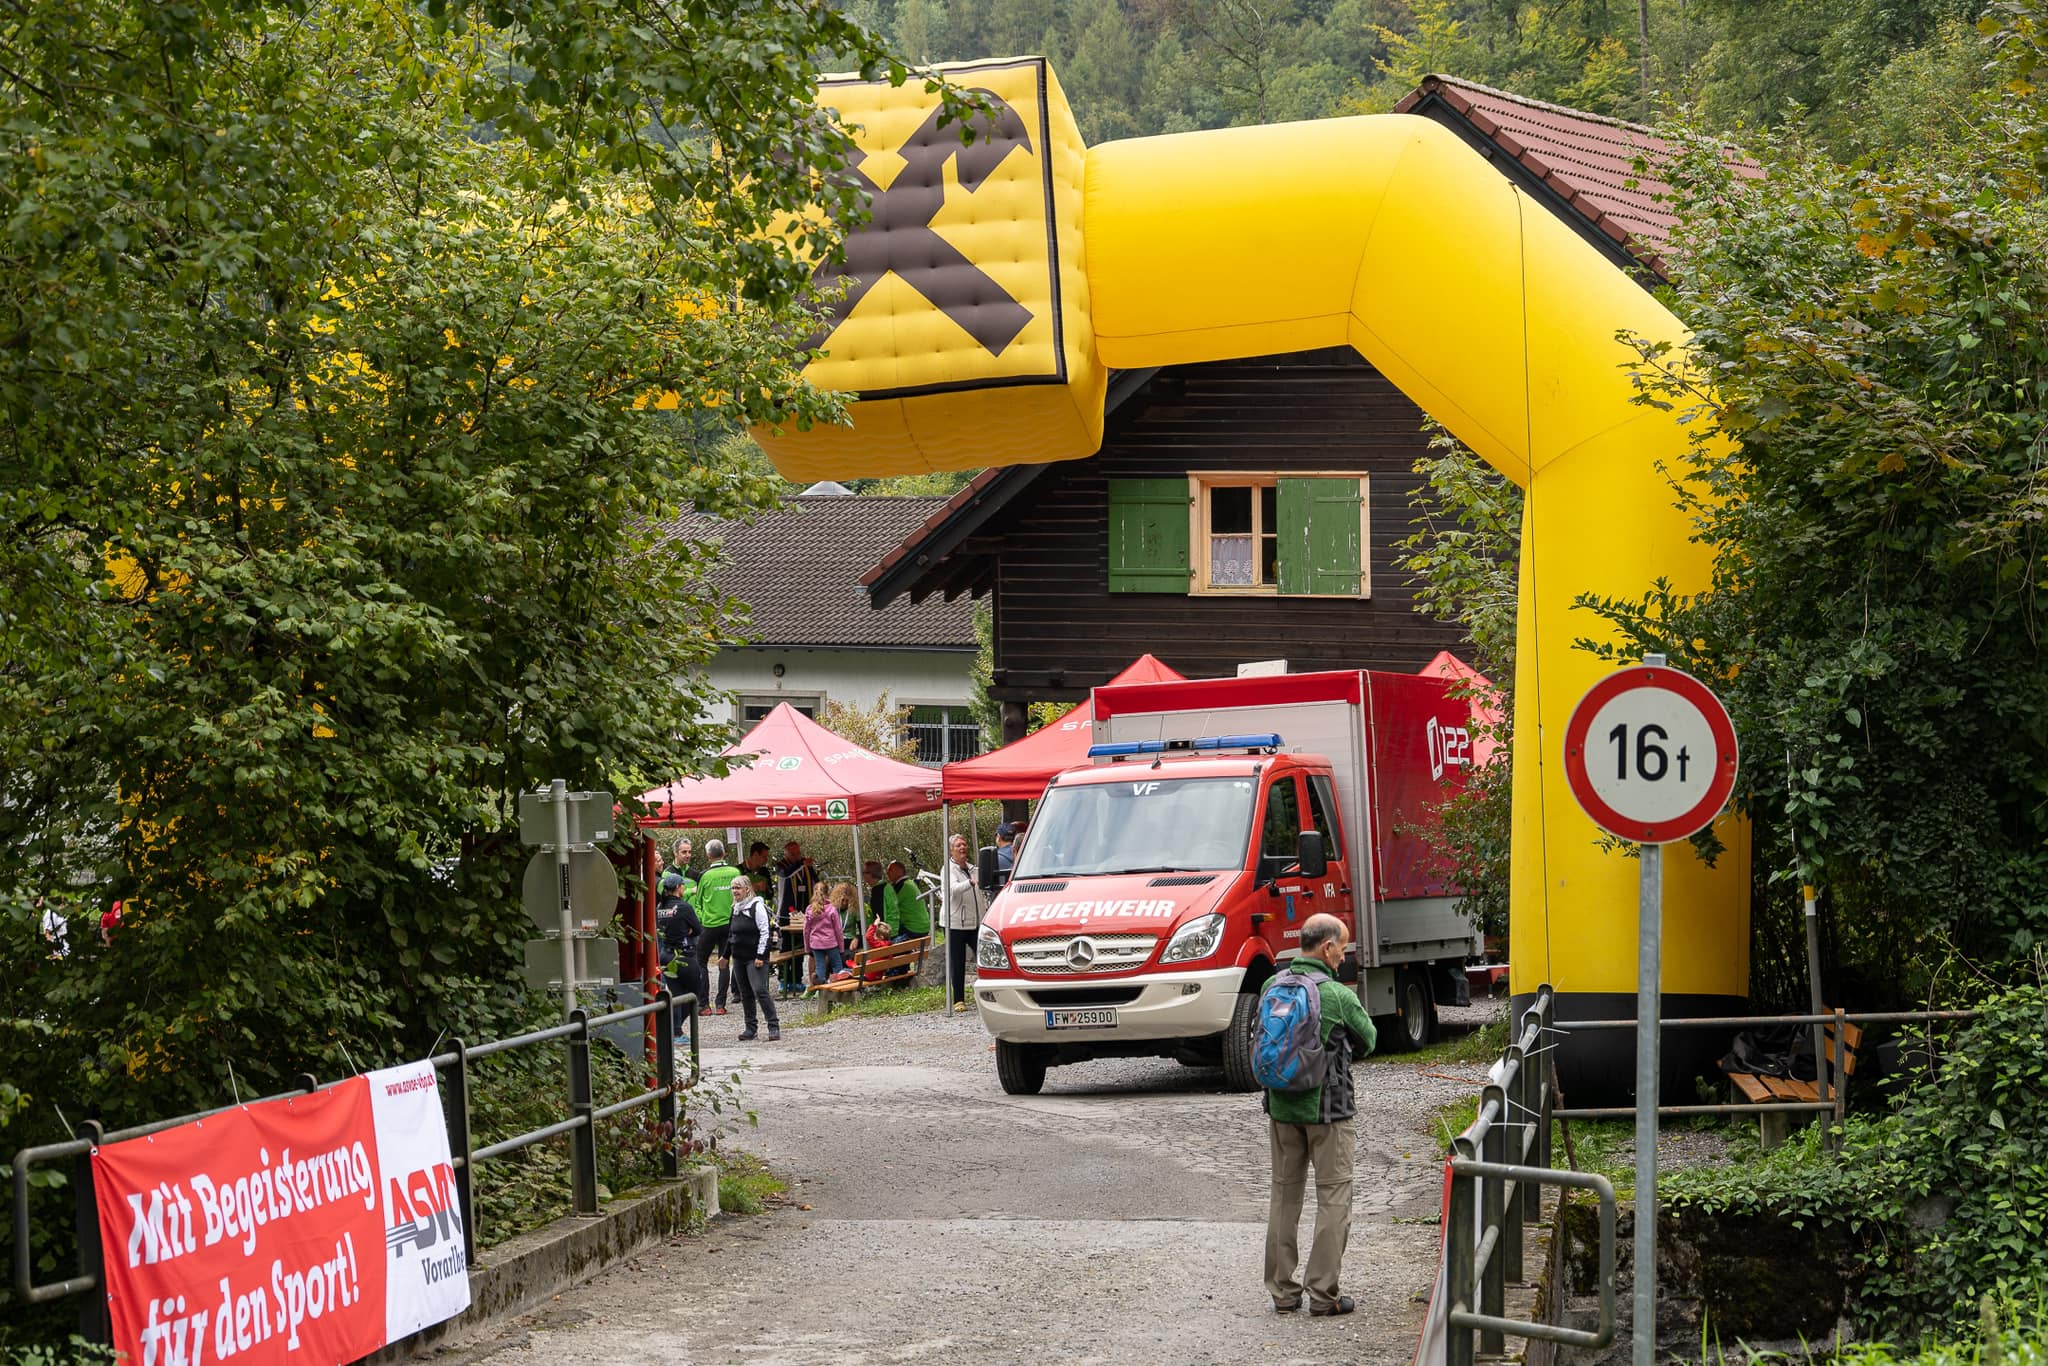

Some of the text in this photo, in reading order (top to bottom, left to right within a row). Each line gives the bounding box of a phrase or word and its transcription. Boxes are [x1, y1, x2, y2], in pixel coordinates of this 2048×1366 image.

[1132, 782, 1161, 797] VF
[755, 804, 822, 819] SPAR
[1009, 900, 1176, 925] FEUERWEHR
[127, 1140, 376, 1269] Mit Begeisterung
[139, 1231, 360, 1366] für den Sport!
